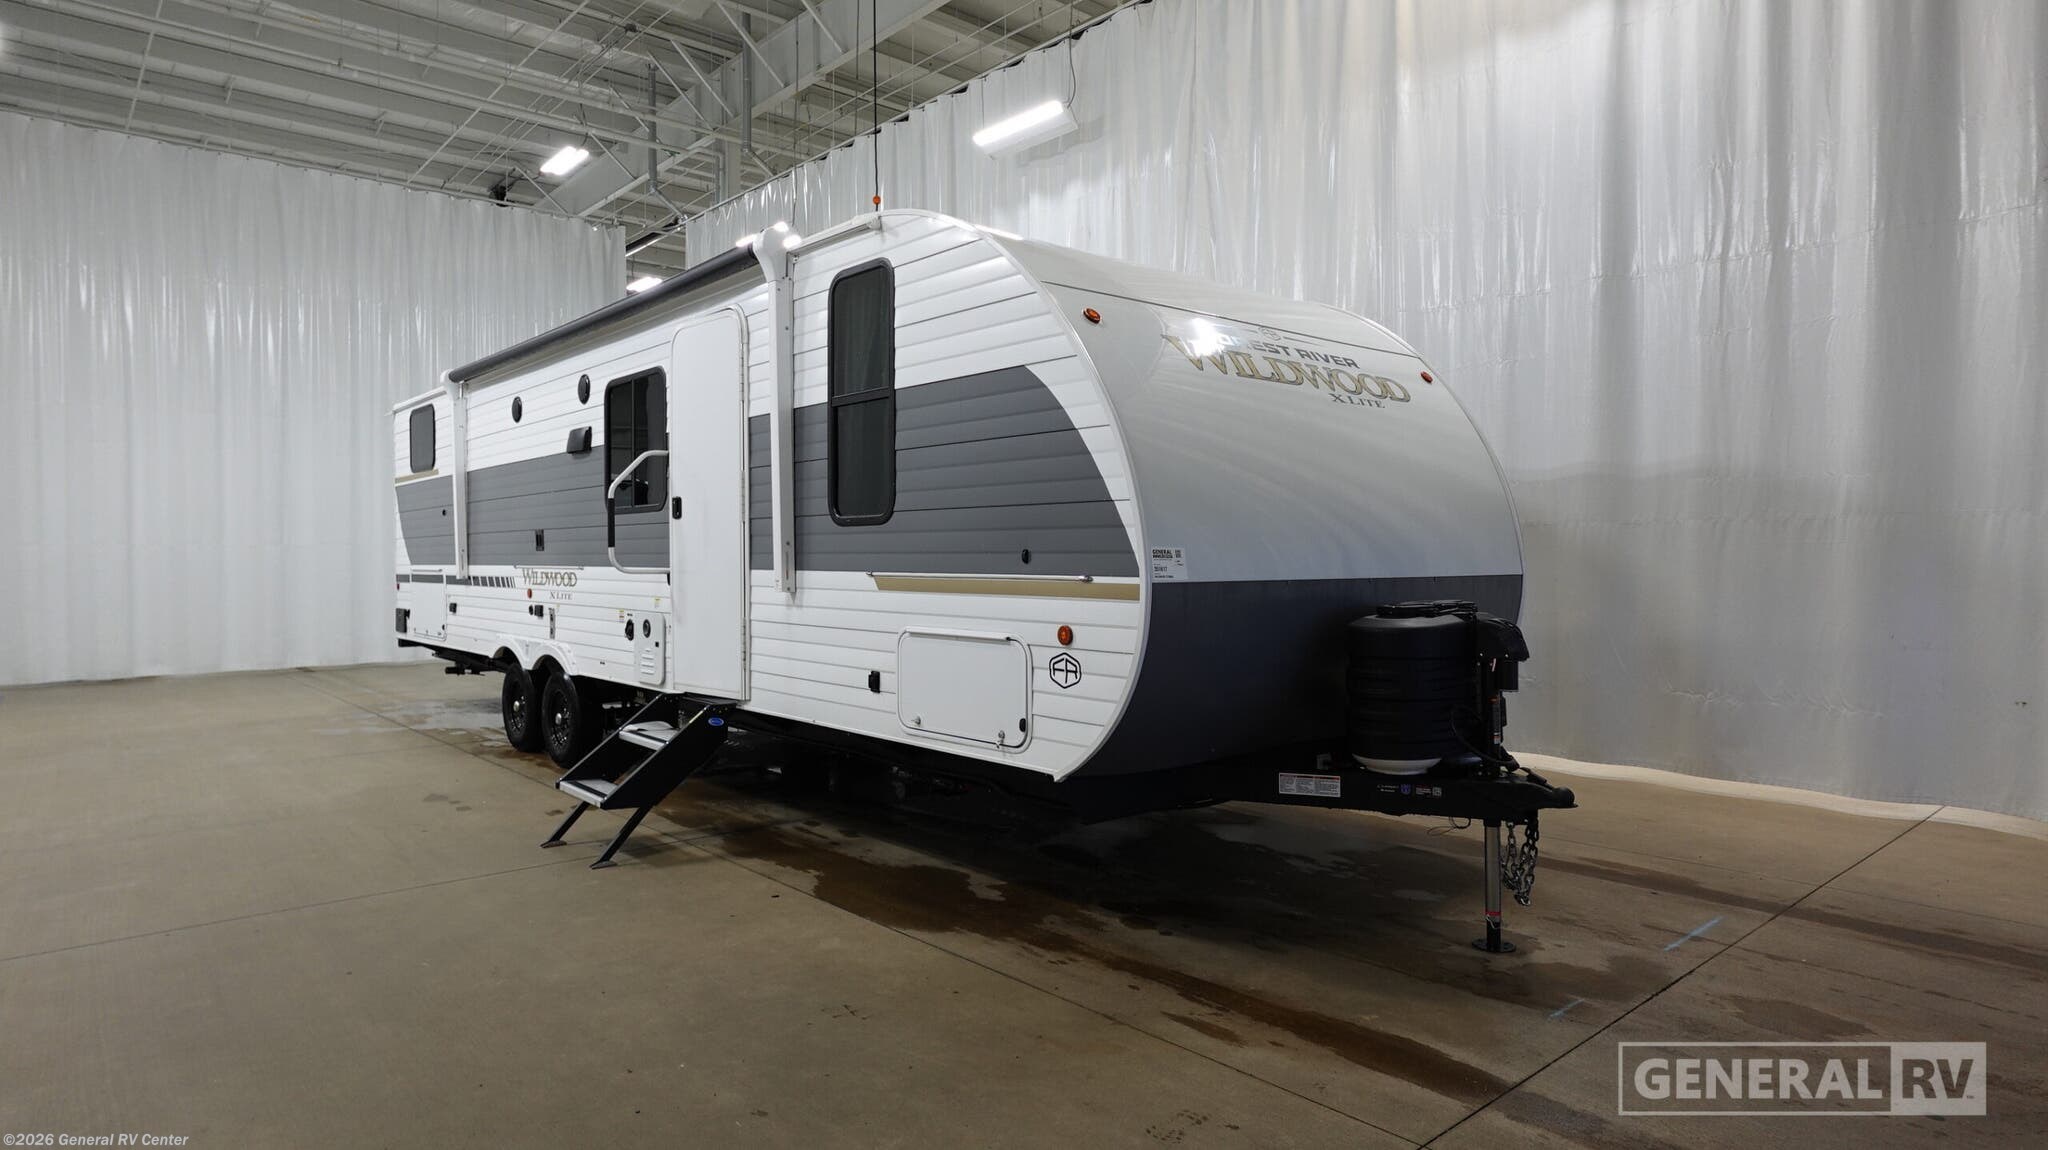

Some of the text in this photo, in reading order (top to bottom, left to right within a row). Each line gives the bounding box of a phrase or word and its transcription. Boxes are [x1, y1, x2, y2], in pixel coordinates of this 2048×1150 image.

[1161, 334, 1411, 402] WILDWOOD
[1293, 347, 1361, 369] RIVER
[522, 567, 578, 587] WILDWOOD
